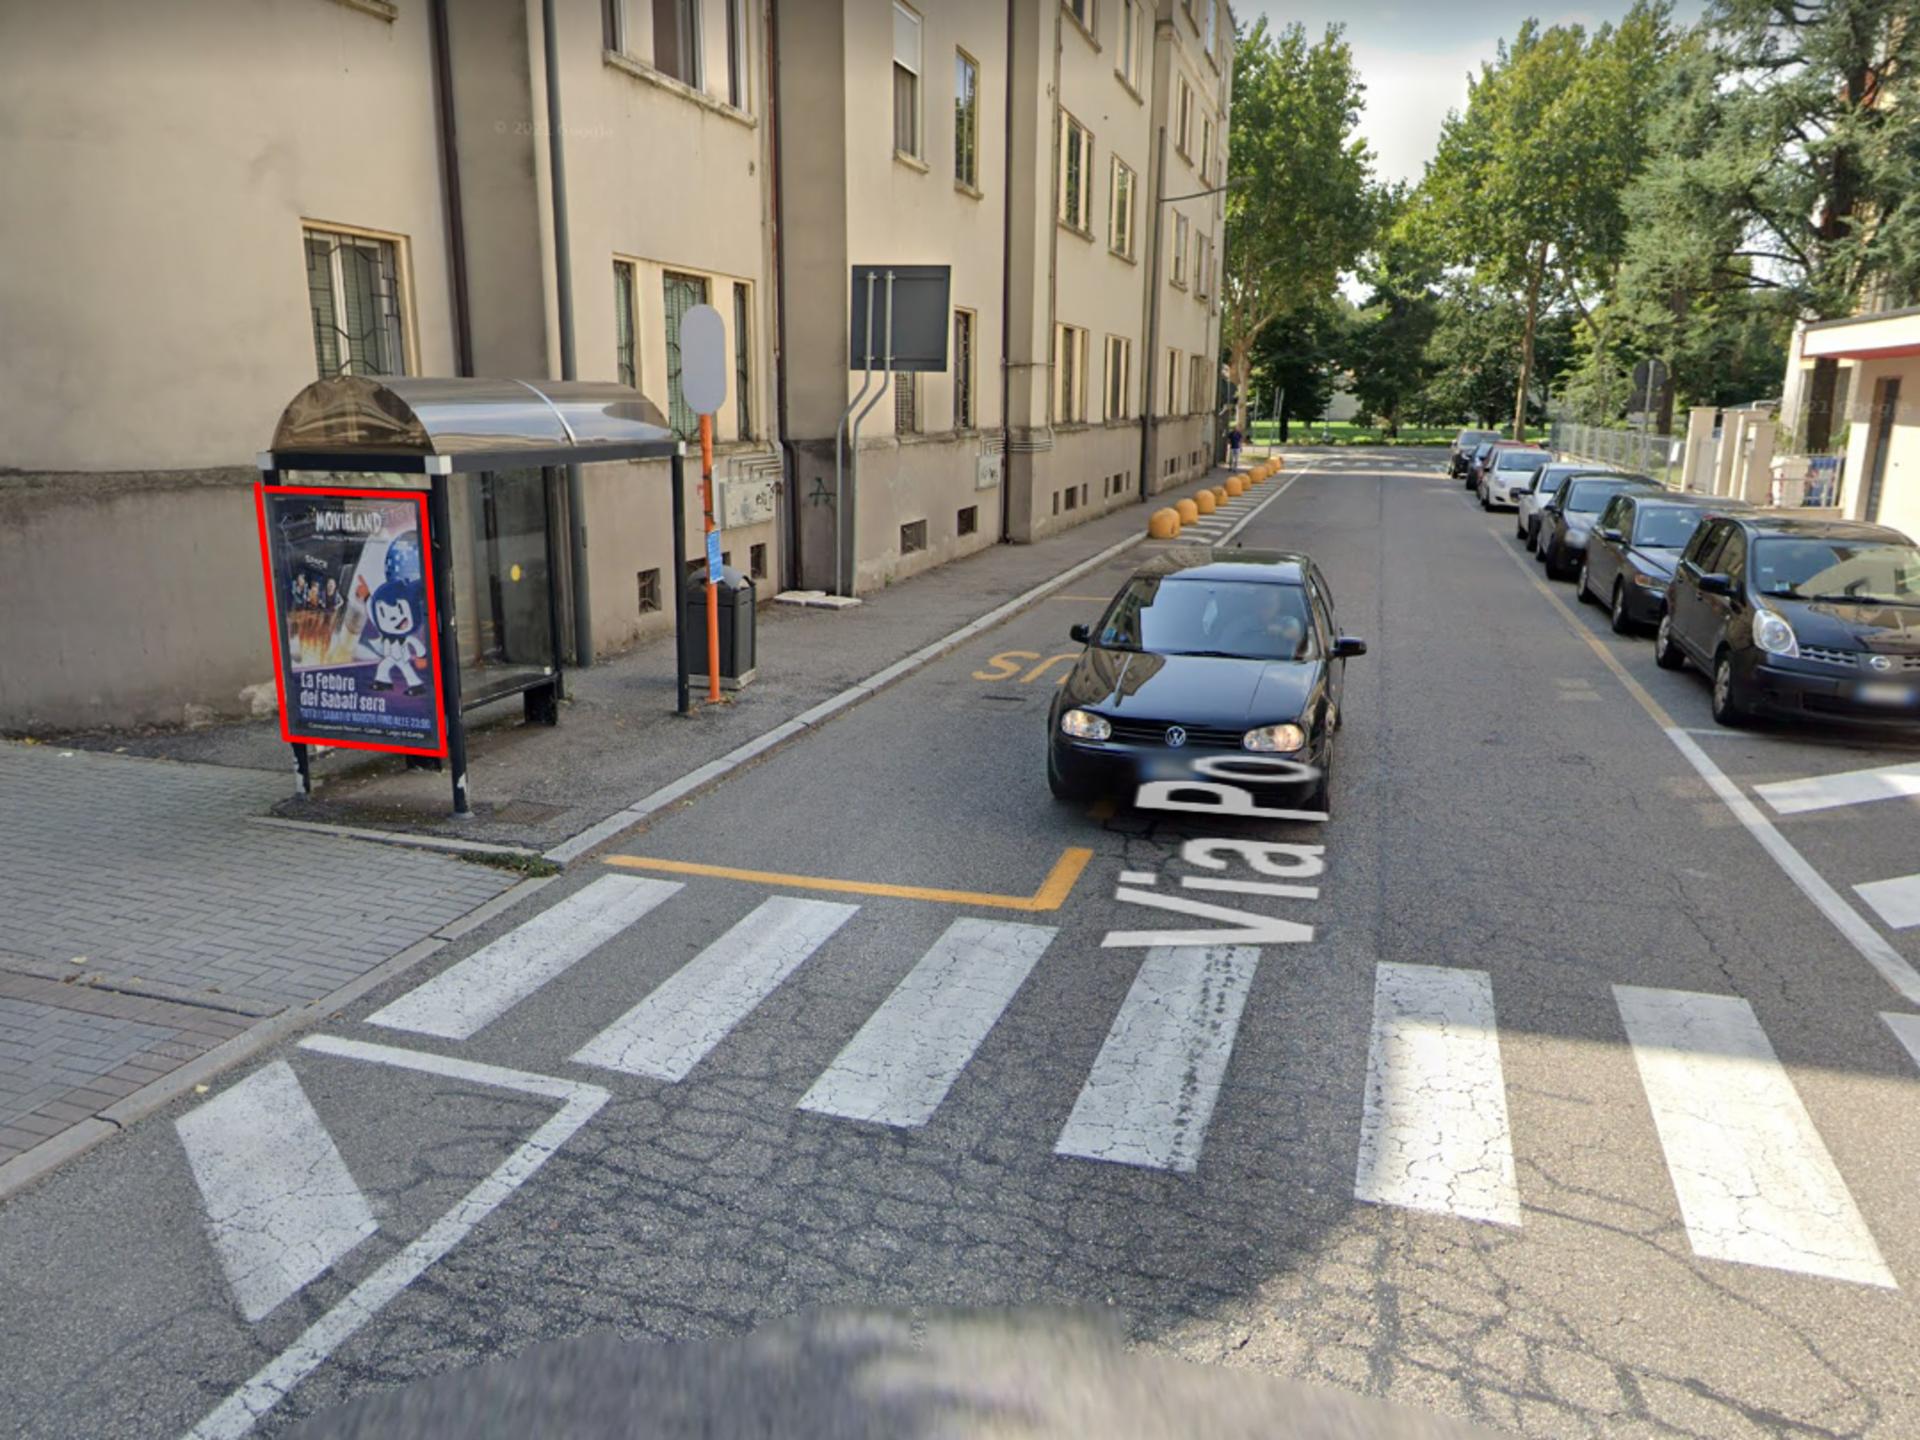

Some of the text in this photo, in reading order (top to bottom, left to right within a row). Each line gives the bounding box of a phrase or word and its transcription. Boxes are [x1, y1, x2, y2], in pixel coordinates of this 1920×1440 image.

[315, 510, 382, 533] MOVIELAND
[300, 672, 356, 692] La Febbre
[300, 690, 386, 713] dei Sabati sera
